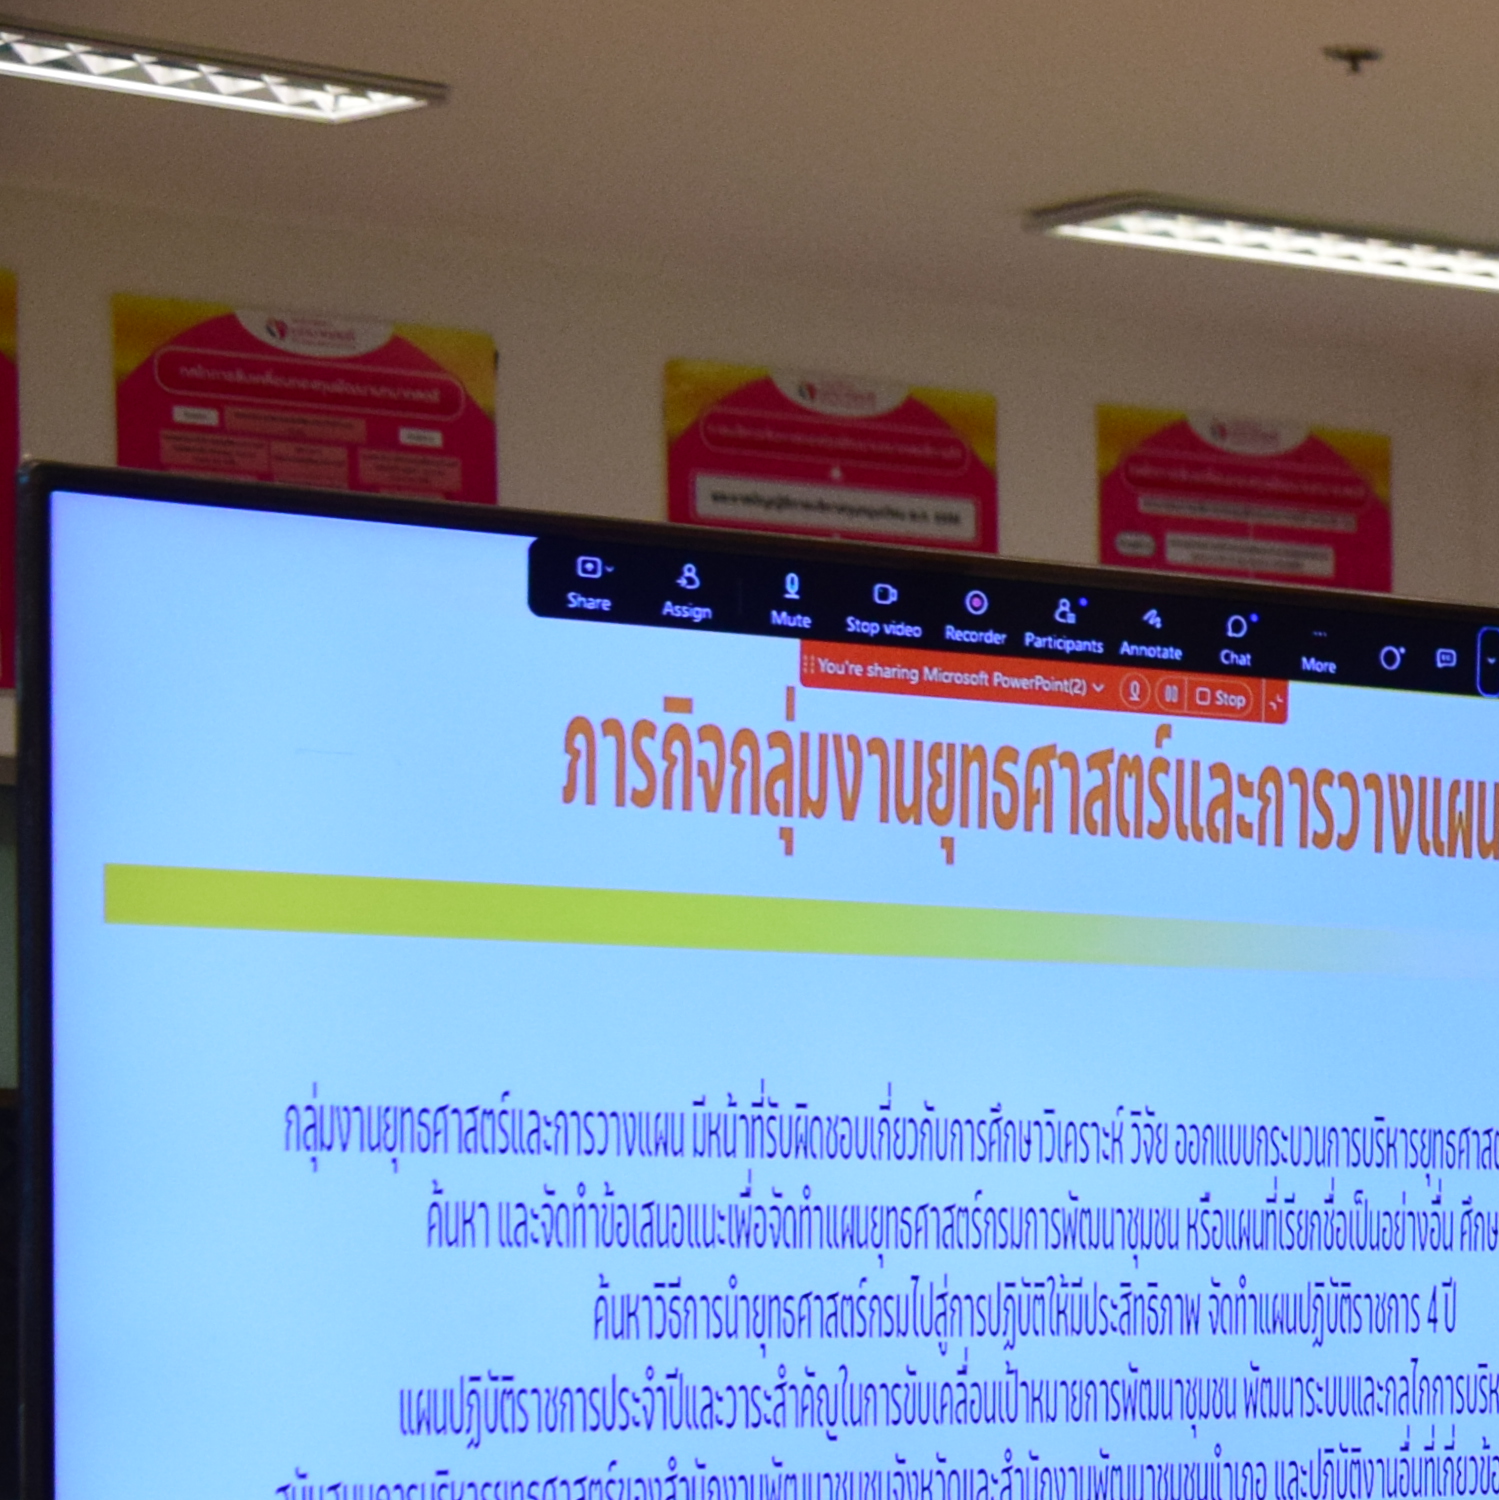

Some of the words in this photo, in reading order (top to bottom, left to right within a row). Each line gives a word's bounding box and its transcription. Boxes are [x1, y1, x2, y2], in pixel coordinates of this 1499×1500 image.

[566, 591, 612, 612] Share
[661, 601, 713, 623] Assign
[770, 609, 812, 629] Mute
[846, 616, 880, 636] Stop
[883, 619, 923, 638] video
[944, 625, 1008, 646] Recorder
[1024, 632, 1104, 654] Participants
[1119, 641, 1183, 661] Annotate
[1219, 648, 1252, 668] Chat
[1301, 657, 1337, 675] More
[817, 657, 864, 678] You're
[866, 662, 920, 685] sharing
[923, 666, 990, 688] Microsoft
[992, 669, 1088, 698] PowerPoint(2)
[1215, 689, 1246, 708] Stop
[284, 1081, 686, 1173] กลุ่มงานยุทธศาสตร์และการวางแผน
[692, 1078, 1125, 1165] มีหน้าที่รับผิดชอบเกี่ยวกับการศึกษาวิเคราะห์
[1130, 1104, 1168, 1165] วิจัย
[427, 1178, 490, 1249] ค้นหา
[498, 1167, 1180, 1269] และจัดทำข้อเสนอแนะเพื่อจัดทำแผนยุทธศาสตร์กรมการพัฒนาชุมชน
[1186, 1176, 1455, 1253] หรือแผนที่เรียกชื่อเป็นอย่างอื่น
[1208, 1273, 1421, 1349] จัดทำแผนปฏิบัติราชการ
[1427, 1284, 1438, 1334] 4
[1441, 1276, 1457, 1334] ปี
